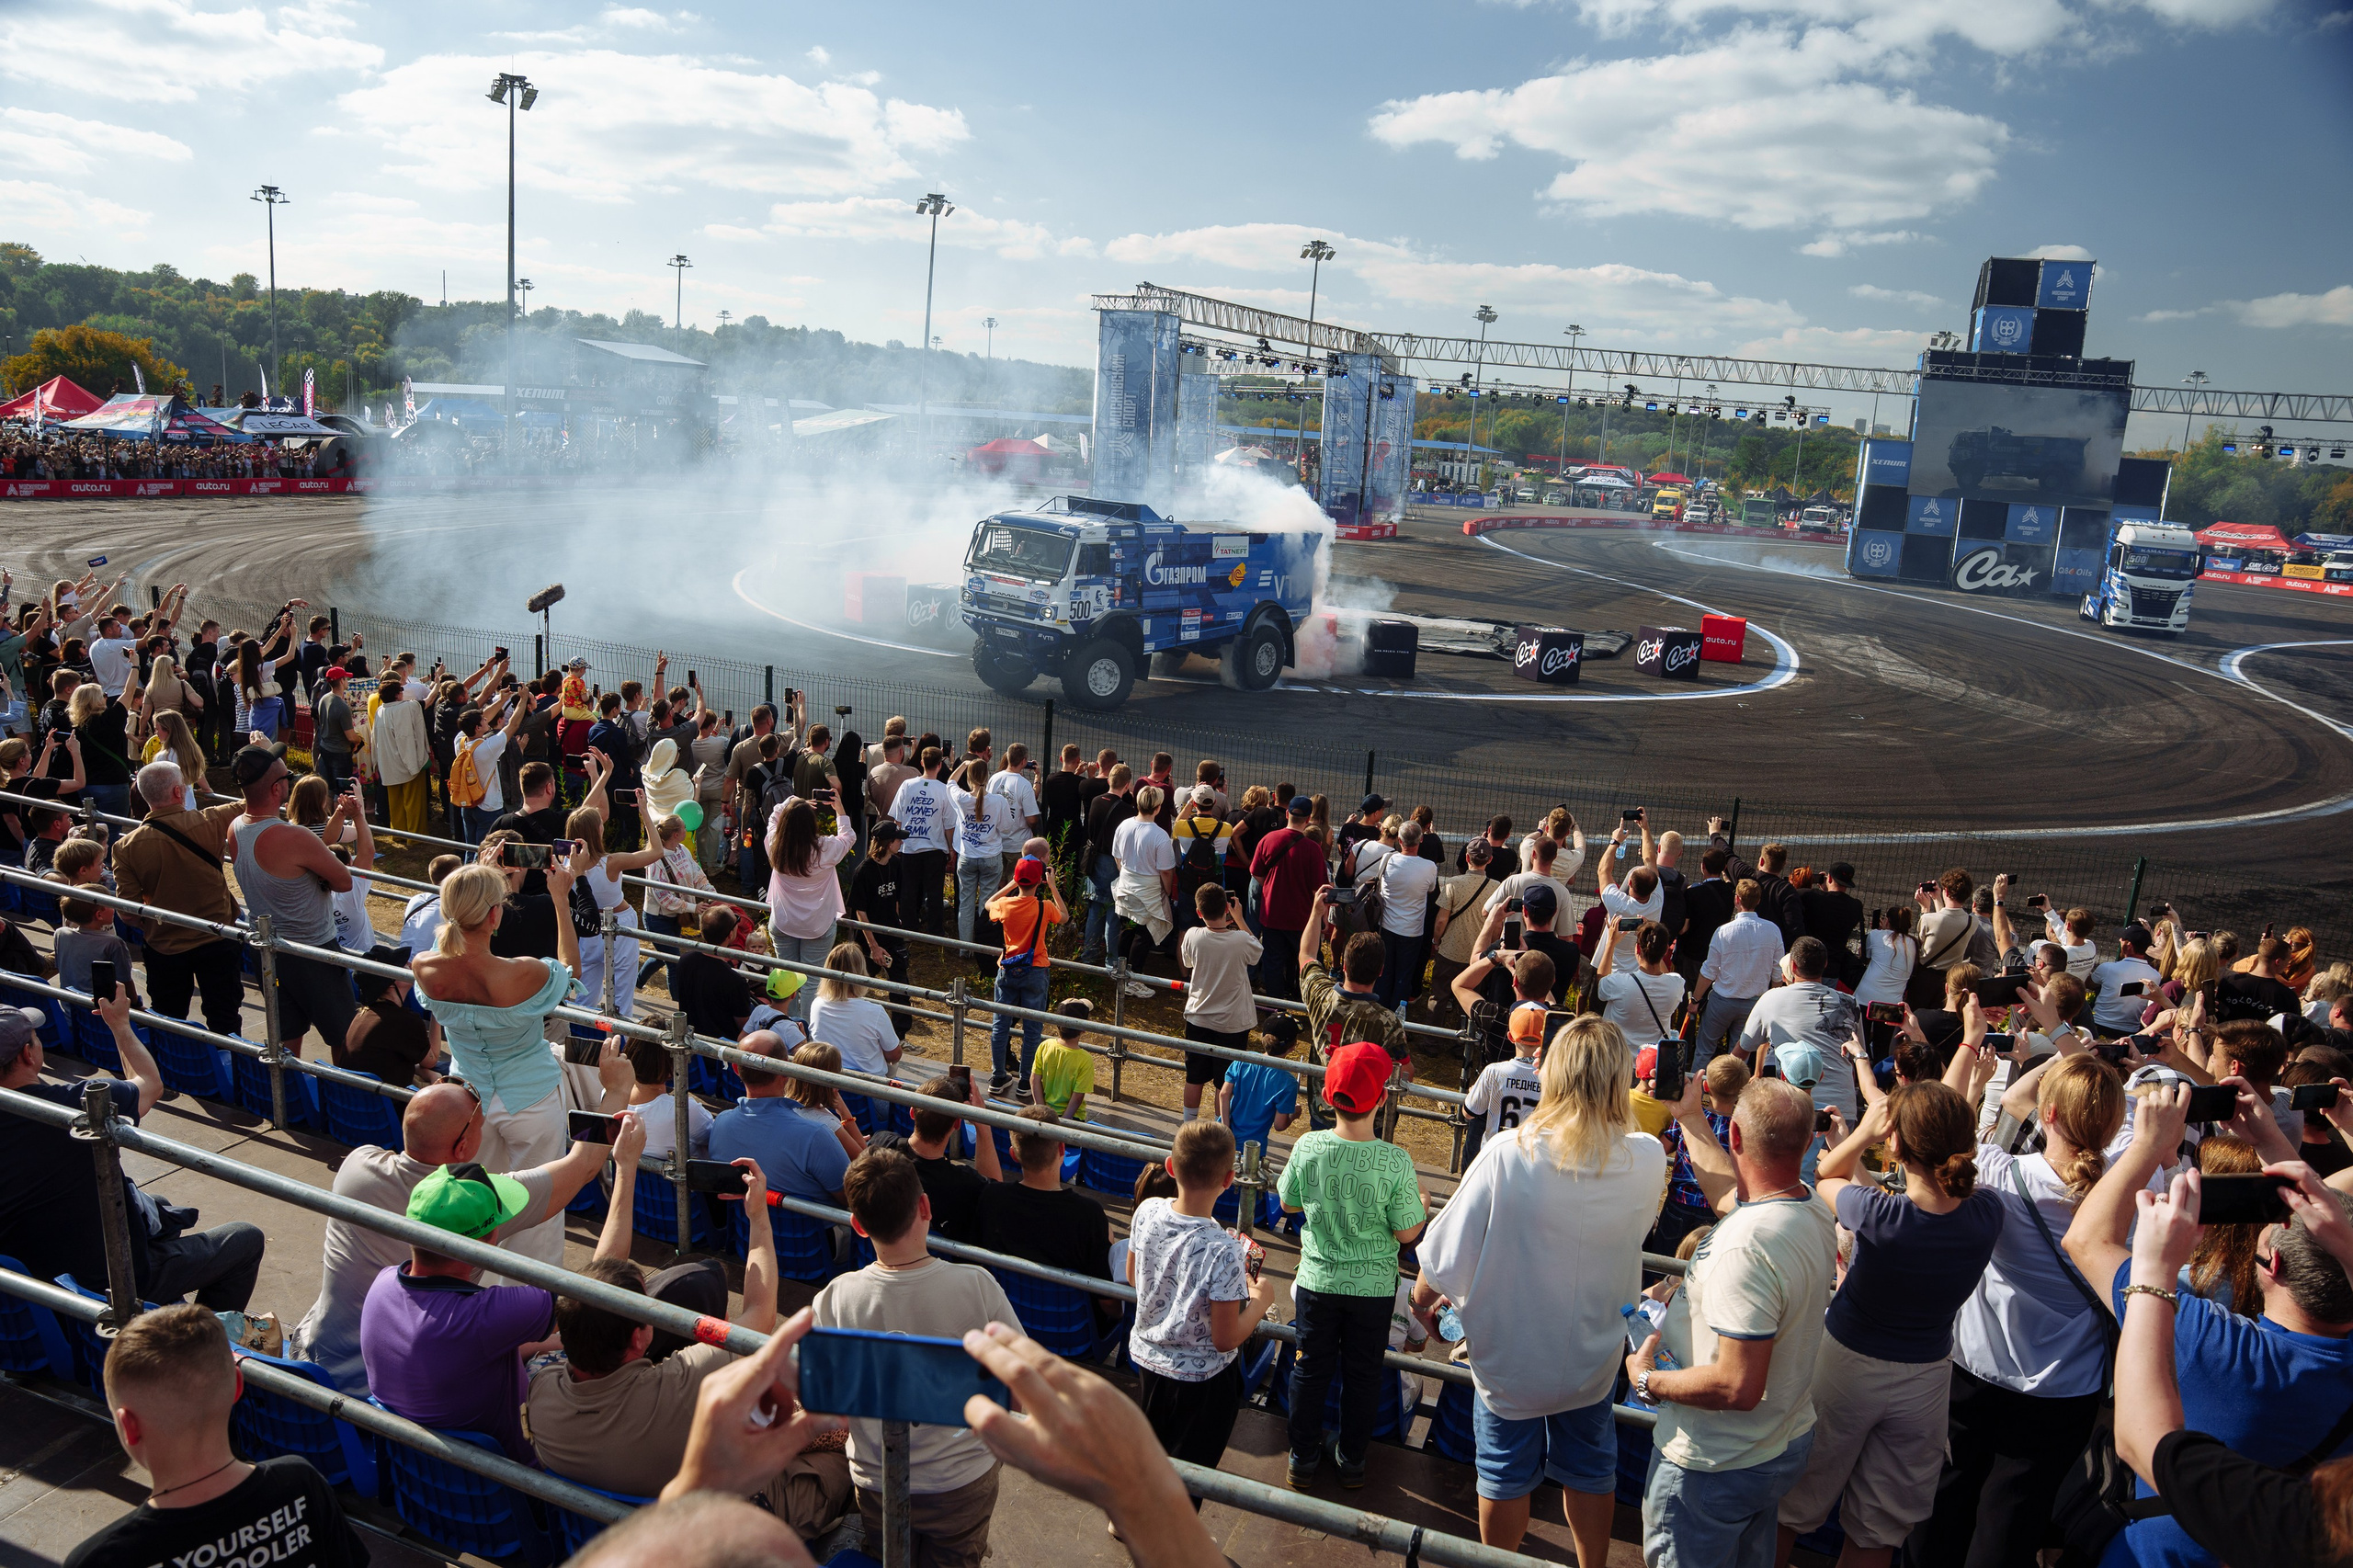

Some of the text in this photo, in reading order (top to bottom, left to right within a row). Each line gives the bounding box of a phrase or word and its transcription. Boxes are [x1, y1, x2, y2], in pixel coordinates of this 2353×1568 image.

[516, 387, 566, 400] XENUM
[1110, 354, 1126, 426] МОСКОВСКИЙ
[1122, 393, 1138, 427] СПОРТ
[260, 420, 314, 430] LECAR
[1871, 459, 1907, 467] XENUM
[71, 483, 111, 493] auto.ru
[299, 481, 329, 489] auto.ru
[1824, 534, 1846, 542] auto.ru
[2129, 555, 2148, 564] 500
[1164, 566, 1207, 585] ГАЗПРОМ
[2076, 568, 2093, 577] Oils
[2204, 572, 2231, 580] auto.ru
[2285, 580, 2312, 588] auto.ru
[991, 590, 1022, 599] KAMAZ
[1069, 600, 1091, 620] 500
[1705, 636, 1737, 646] auto.ru
[910, 796, 935, 805] NEED
[905, 806, 938, 817] MONEY
[910, 817, 926, 825] FOR
[904, 825, 932, 837] BMW
[1328, 1141, 1405, 1174] VIBES
[1324, 1173, 1393, 1209] GOOD
[480, 1213, 495, 1230] 46
[1322, 1230, 1387, 1264] GOOD
[172, 1495, 307, 1568] YOURSELF
[217, 1524, 313, 1568] OOLER
